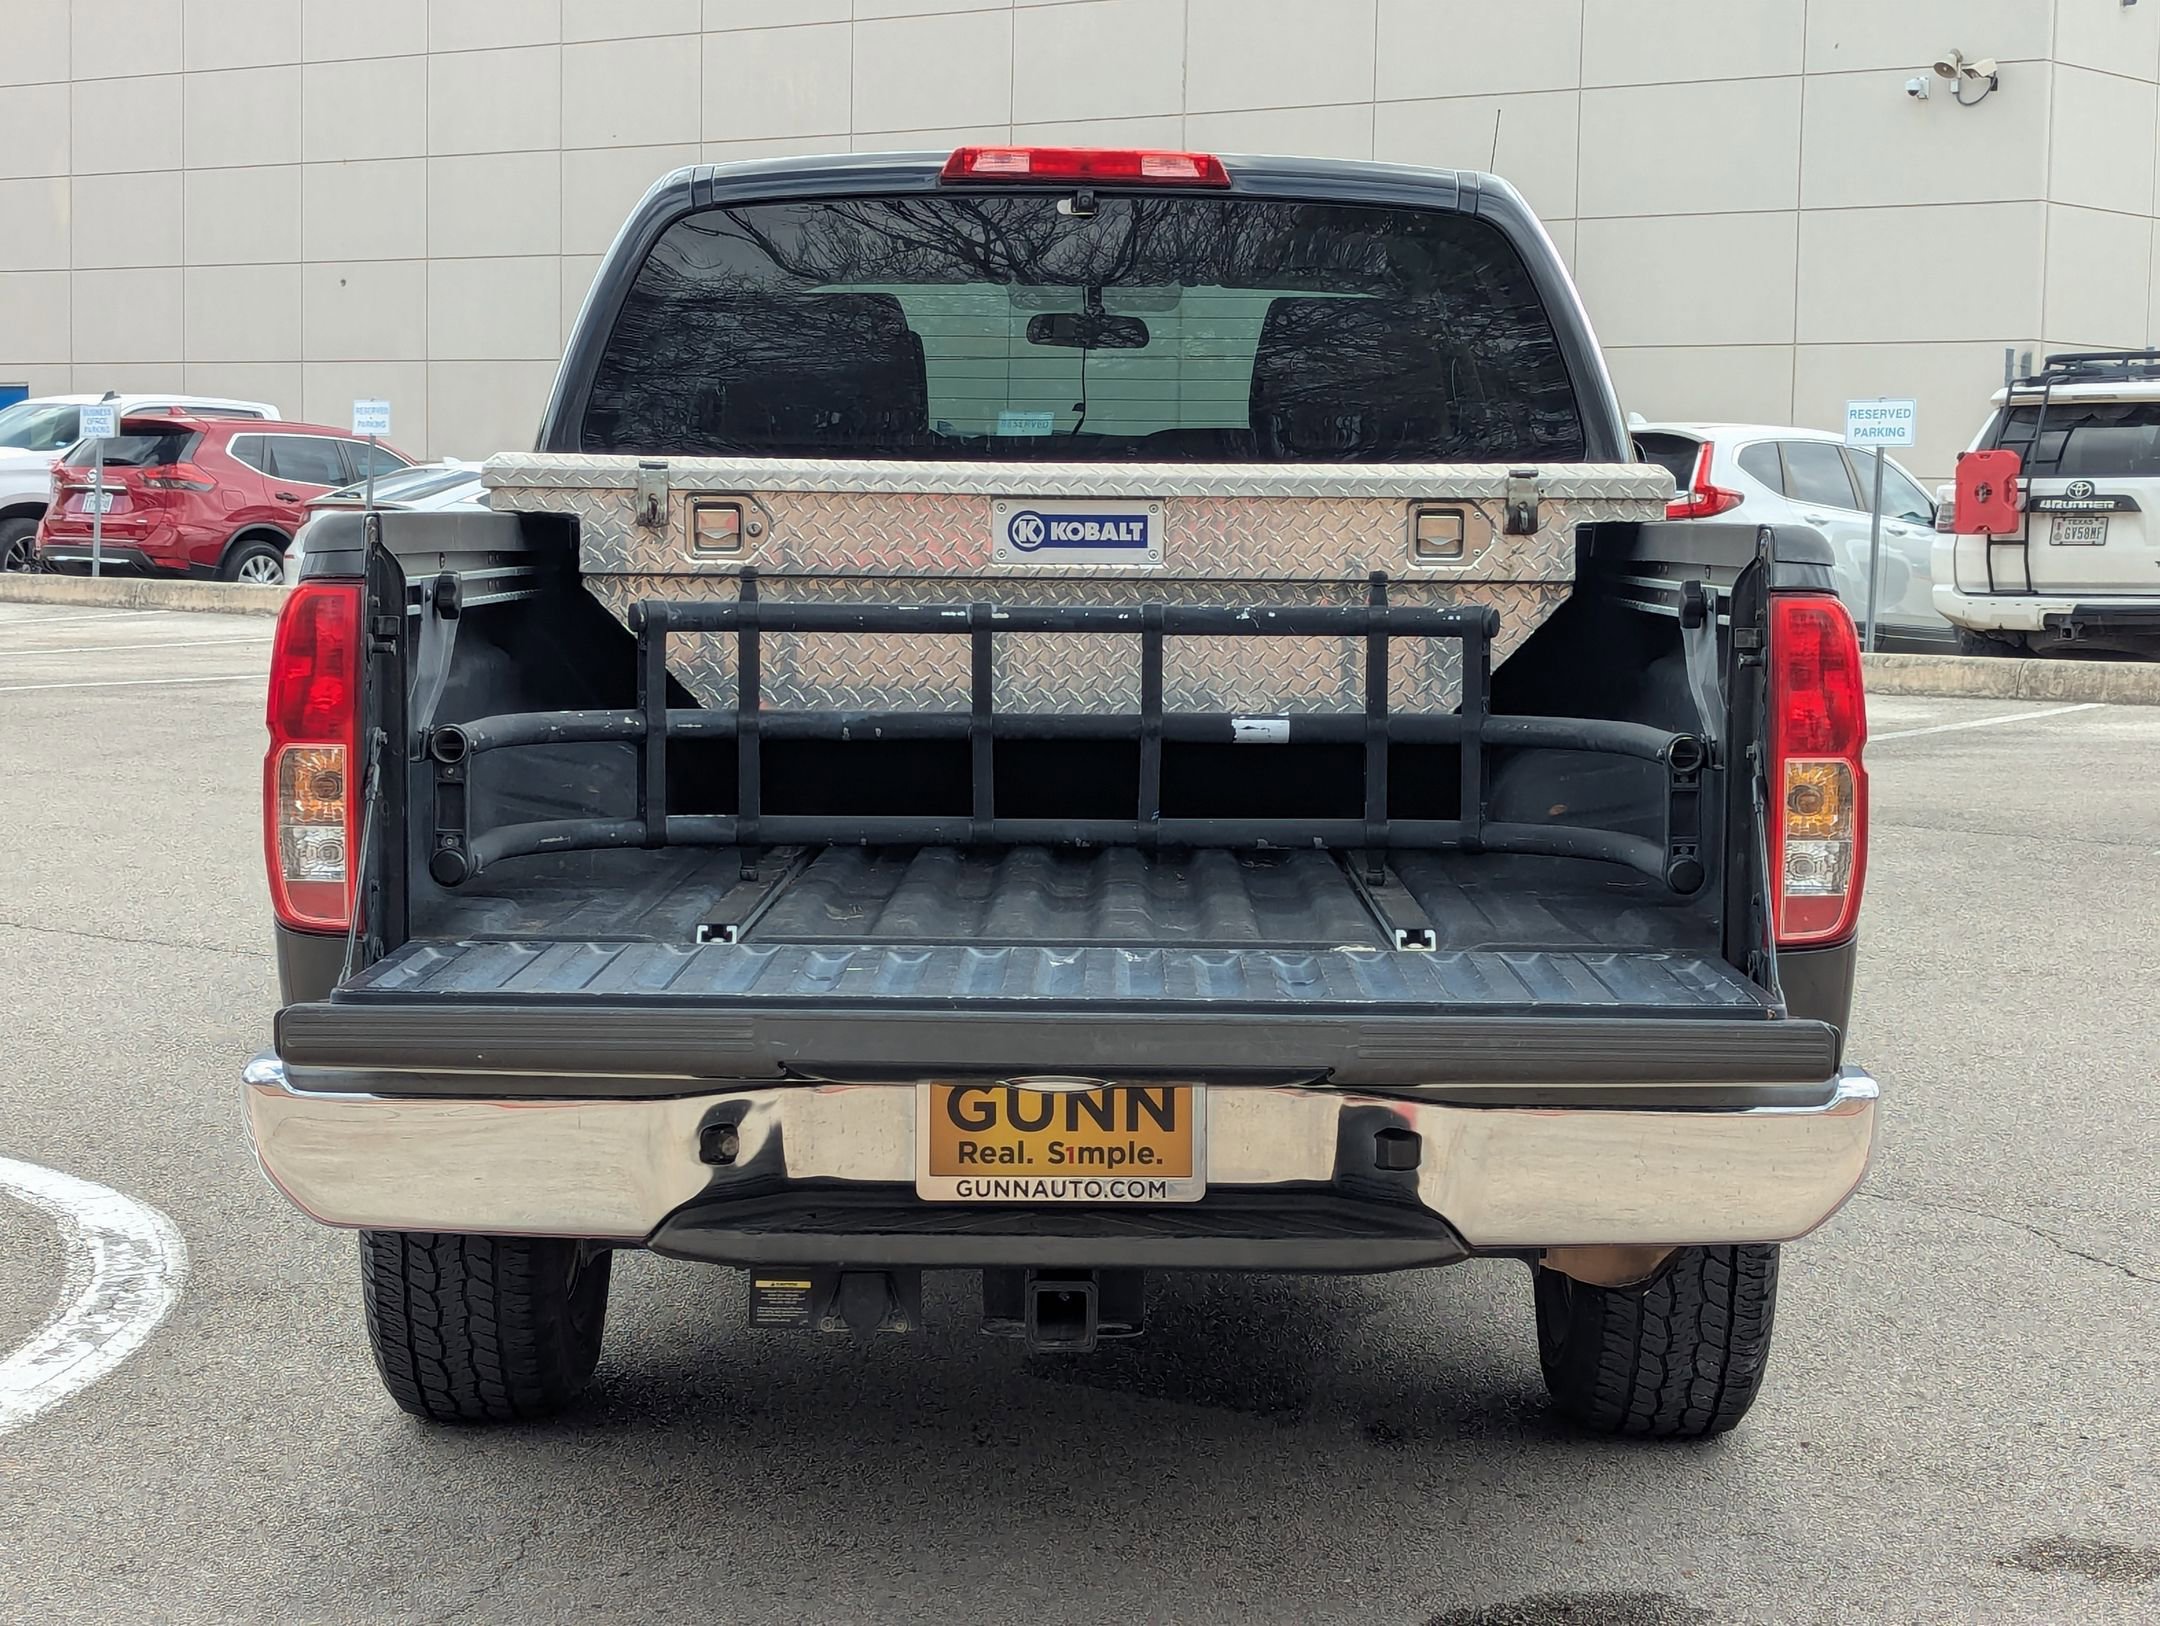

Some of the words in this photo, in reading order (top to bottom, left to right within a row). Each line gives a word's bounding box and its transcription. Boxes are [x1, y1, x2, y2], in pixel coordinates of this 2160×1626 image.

[355, 406, 389, 415] RESERVED
[1849, 408, 1912, 420] RESERVED
[357, 420, 387, 429] PARKING
[1853, 427, 1906, 438] PARKING
[2039, 499, 2115, 509] 4RUNNER
[1050, 521, 1144, 541] KOBALT
[946, 1085, 1176, 1133] GUNN
[958, 1140, 1034, 1165] Real.
[956, 1180, 1167, 1199] GUNNAUTO.COM
